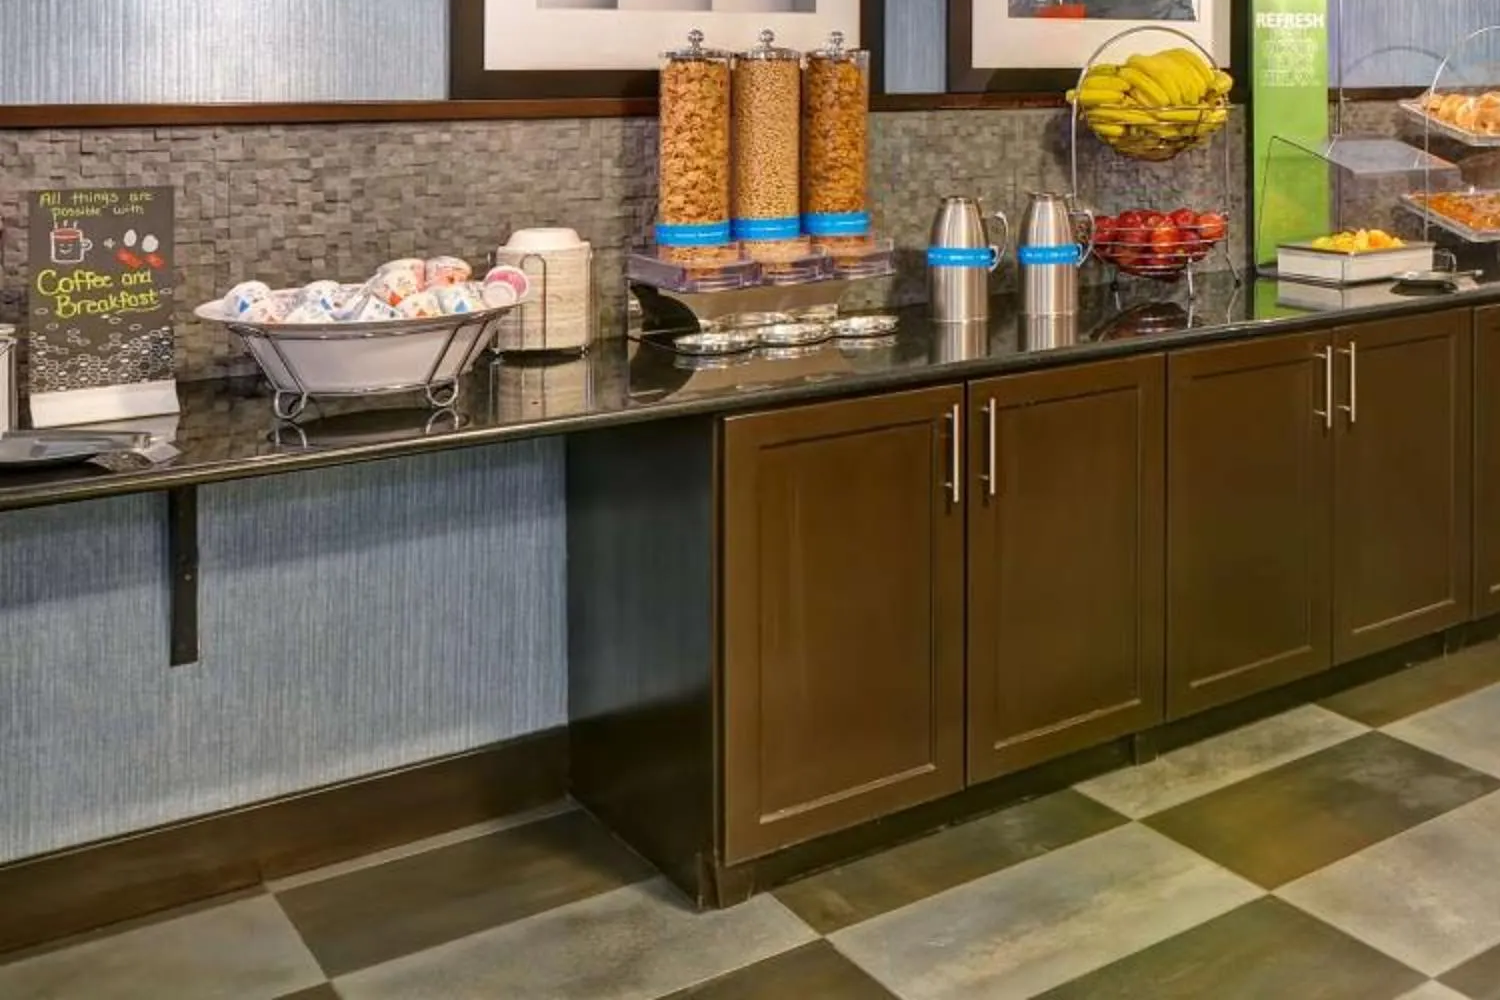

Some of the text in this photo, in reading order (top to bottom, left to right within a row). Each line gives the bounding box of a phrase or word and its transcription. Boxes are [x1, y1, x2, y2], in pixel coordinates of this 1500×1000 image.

[1256, 12, 1324, 28] REFRESH
[40, 190, 154, 207] All things are
[51, 204, 145, 219] possible with
[37, 268, 153, 296] Coffee and
[55, 287, 162, 319] Breakfast
